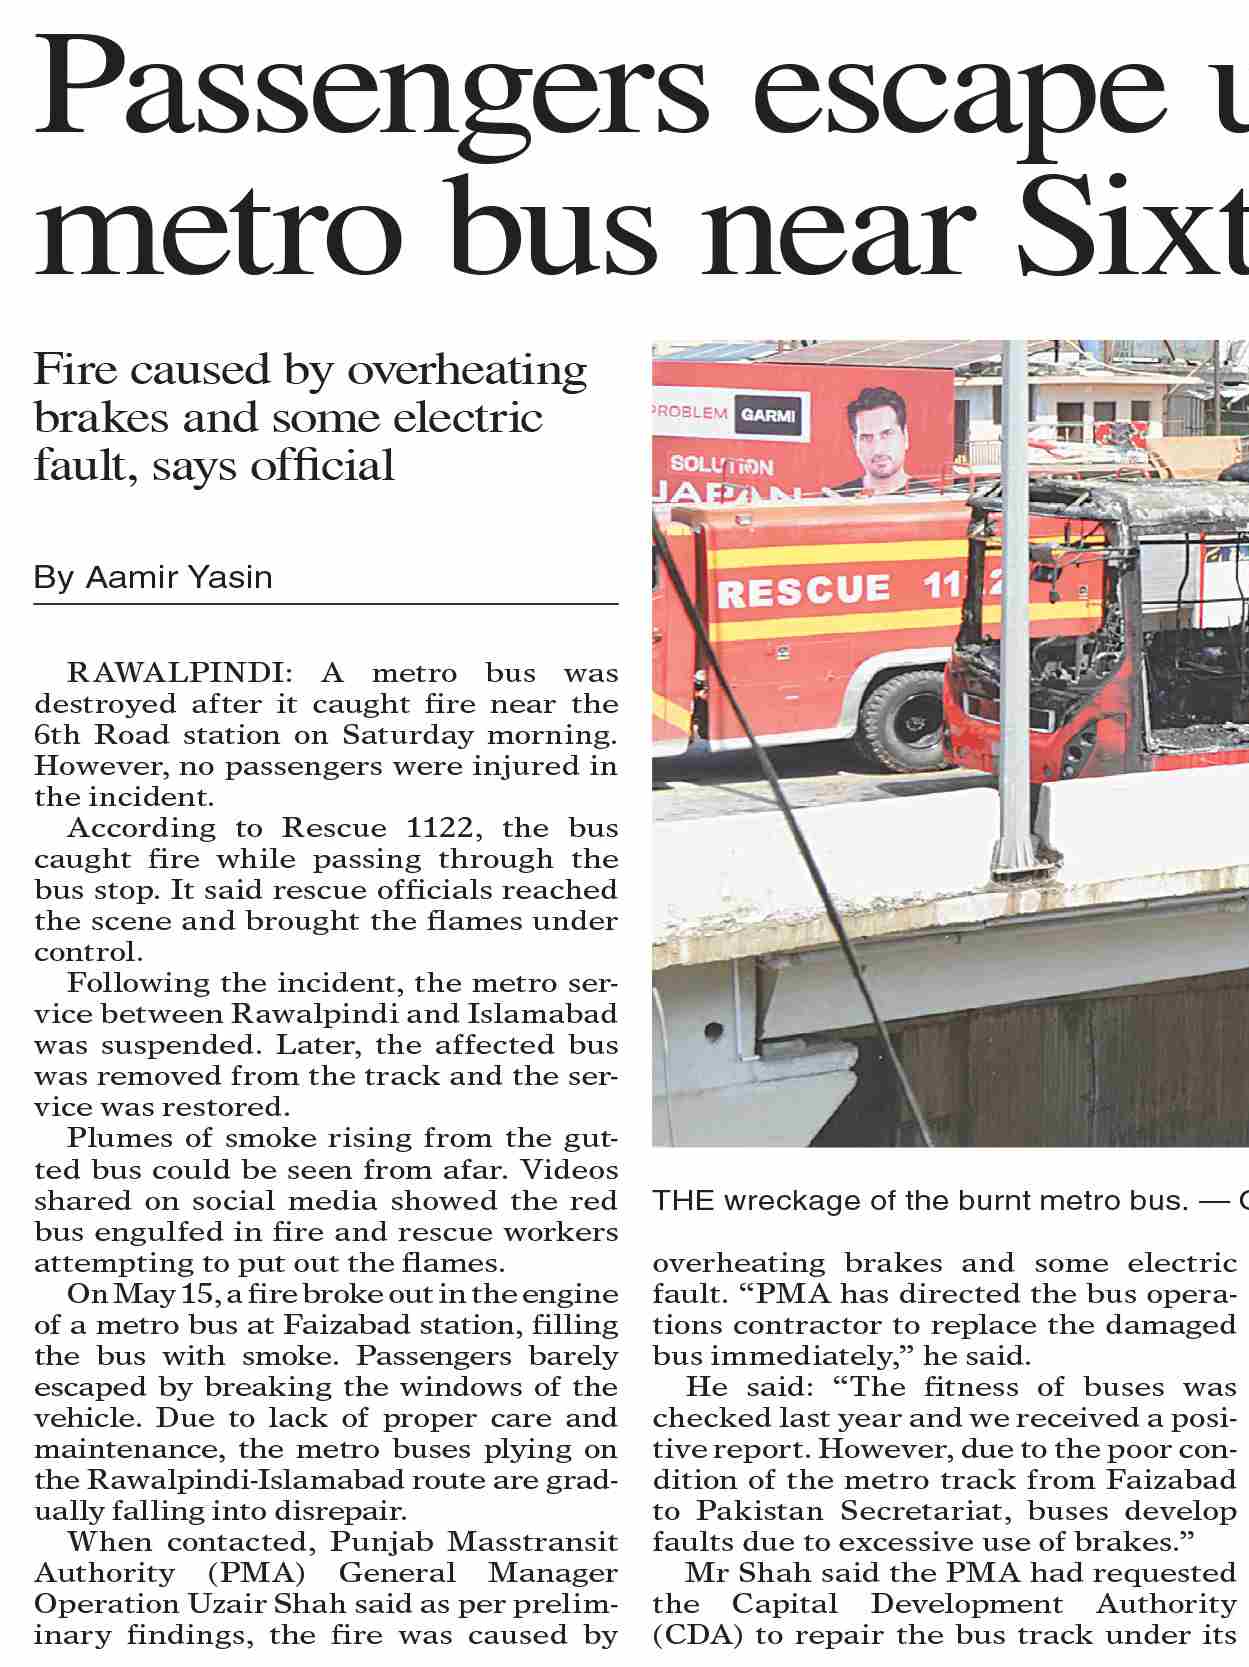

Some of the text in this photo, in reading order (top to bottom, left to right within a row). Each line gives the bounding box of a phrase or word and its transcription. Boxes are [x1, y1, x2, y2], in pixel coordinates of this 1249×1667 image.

[35, 33, 710, 165] Passengers
[754, 63, 1168, 165] escape
[35, 187, 402, 276] metro
[441, 172, 658, 276] bus
[701, 205, 978, 276] near
[33, 351, 588, 395] Fire caused by overheating
[32, 399, 543, 433] brakes and some electric
[741, 408, 796, 423] GARMI
[33, 446, 396, 491] fault, says official
[671, 454, 775, 476] SOLUTION
[34, 564, 272, 595] By Aamir Yasin
[718, 568, 1004, 609] RESCUE 112
[67, 661, 619, 683] RAWALPINDI: A metro bus was
[34, 723, 617, 750] 6th Road station on Saturday morning.
[66, 816, 619, 843] According to Rescue 1122, the bus
[67, 971, 619, 998] Following the incident, the metro ser-
[34, 1189, 618, 1211] shared on social media showed the red
[652, 1189, 715, 1211] THE
[724, 1189, 861, 1217] wreckage
[870, 1189, 897, 1211] of
[905, 1189, 949, 1211] the
[959, 1189, 1031, 1211] burnt
[1040, 1190, 1121, 1211] metro
[1130, 1189, 1188, 1211] bus.
[653, 1251, 1237, 1278] overheating brakes and some electric
[686, 1375, 1237, 1397] He said: “The fitness of buses was
[35, 1468, 618, 1495] the Rawalpindi-Islamabad route are grad-
[653, 1499, 1237, 1526] to Pakistan Secretariat, buses develop
[66, 1530, 618, 1557] When contacted, Punjab Masstransit
[652, 1592, 1238, 1619] the Capital Development Authority
